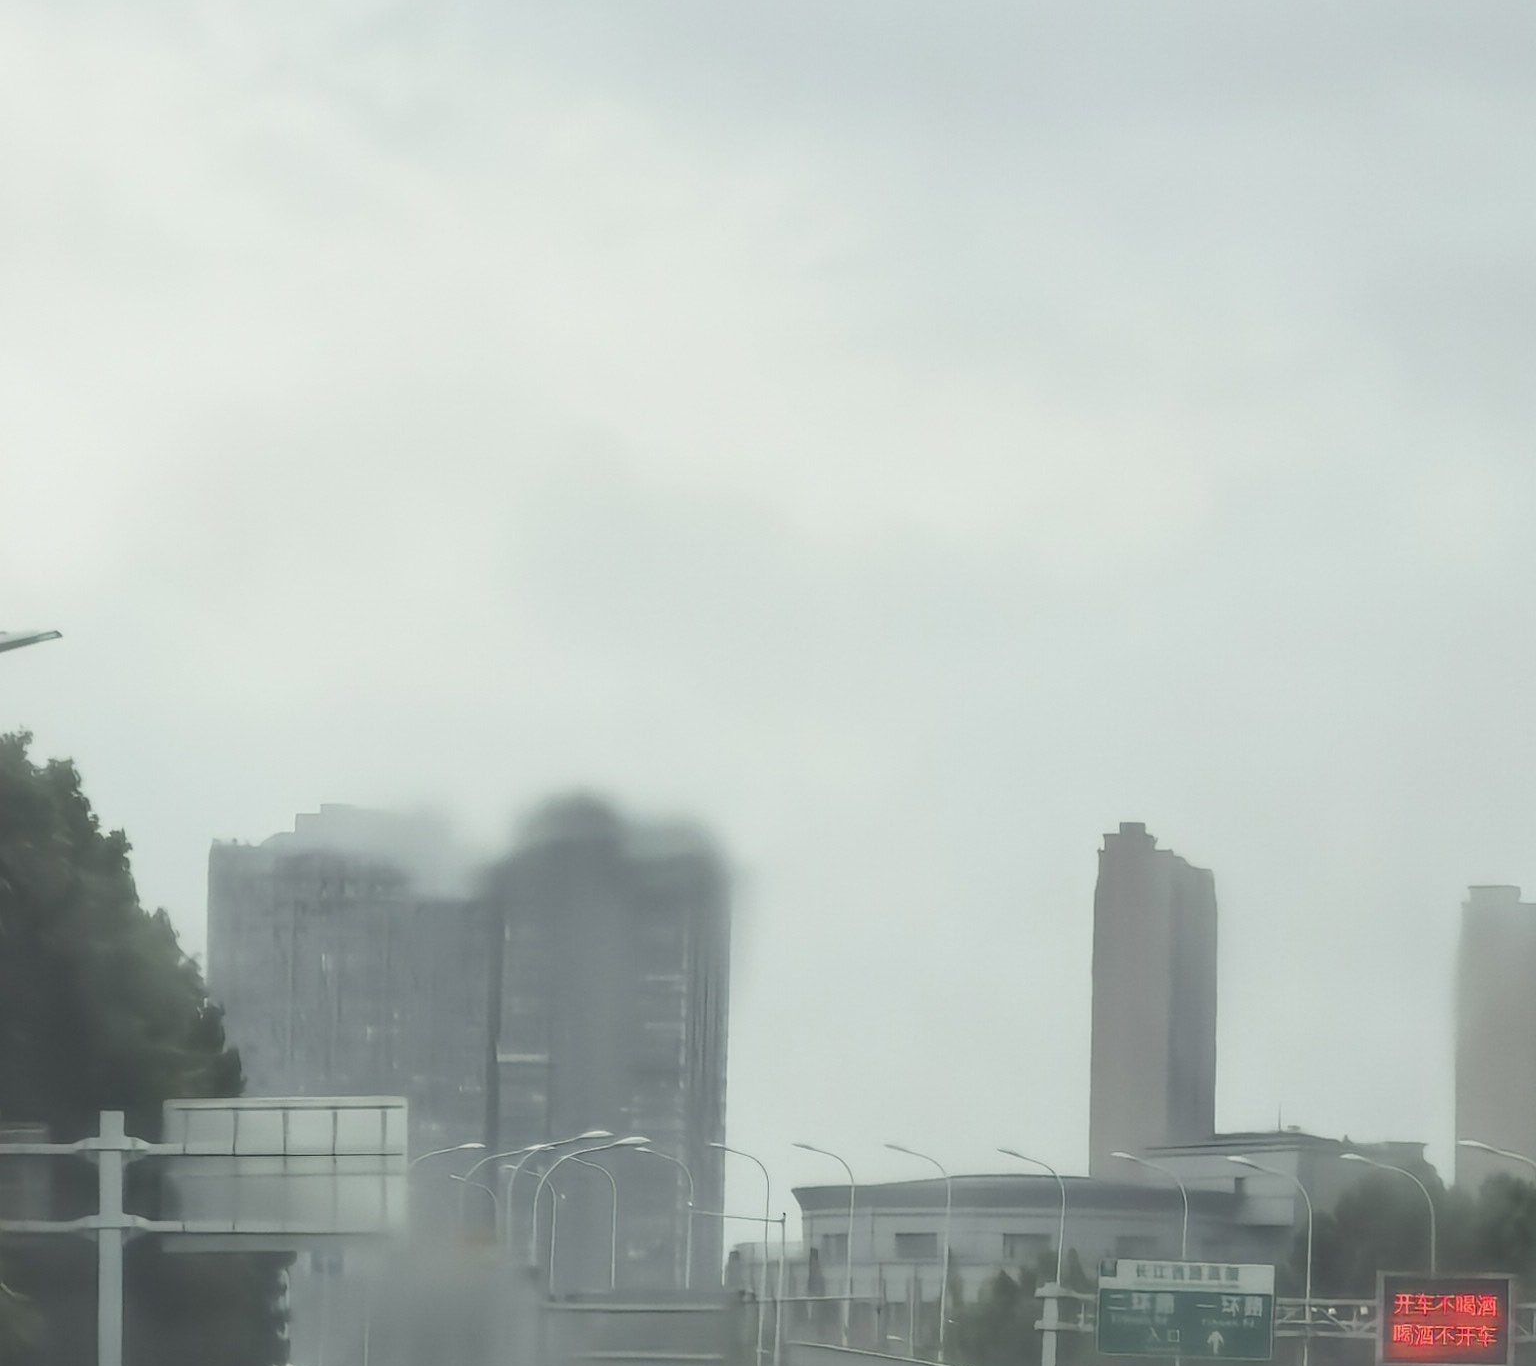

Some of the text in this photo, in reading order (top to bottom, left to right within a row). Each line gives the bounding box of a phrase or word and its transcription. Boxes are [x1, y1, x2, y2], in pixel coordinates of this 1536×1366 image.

[1394, 1293, 1497, 1316] 开车不喝酒
[1392, 1324, 1497, 1347] 喝酒不开车
